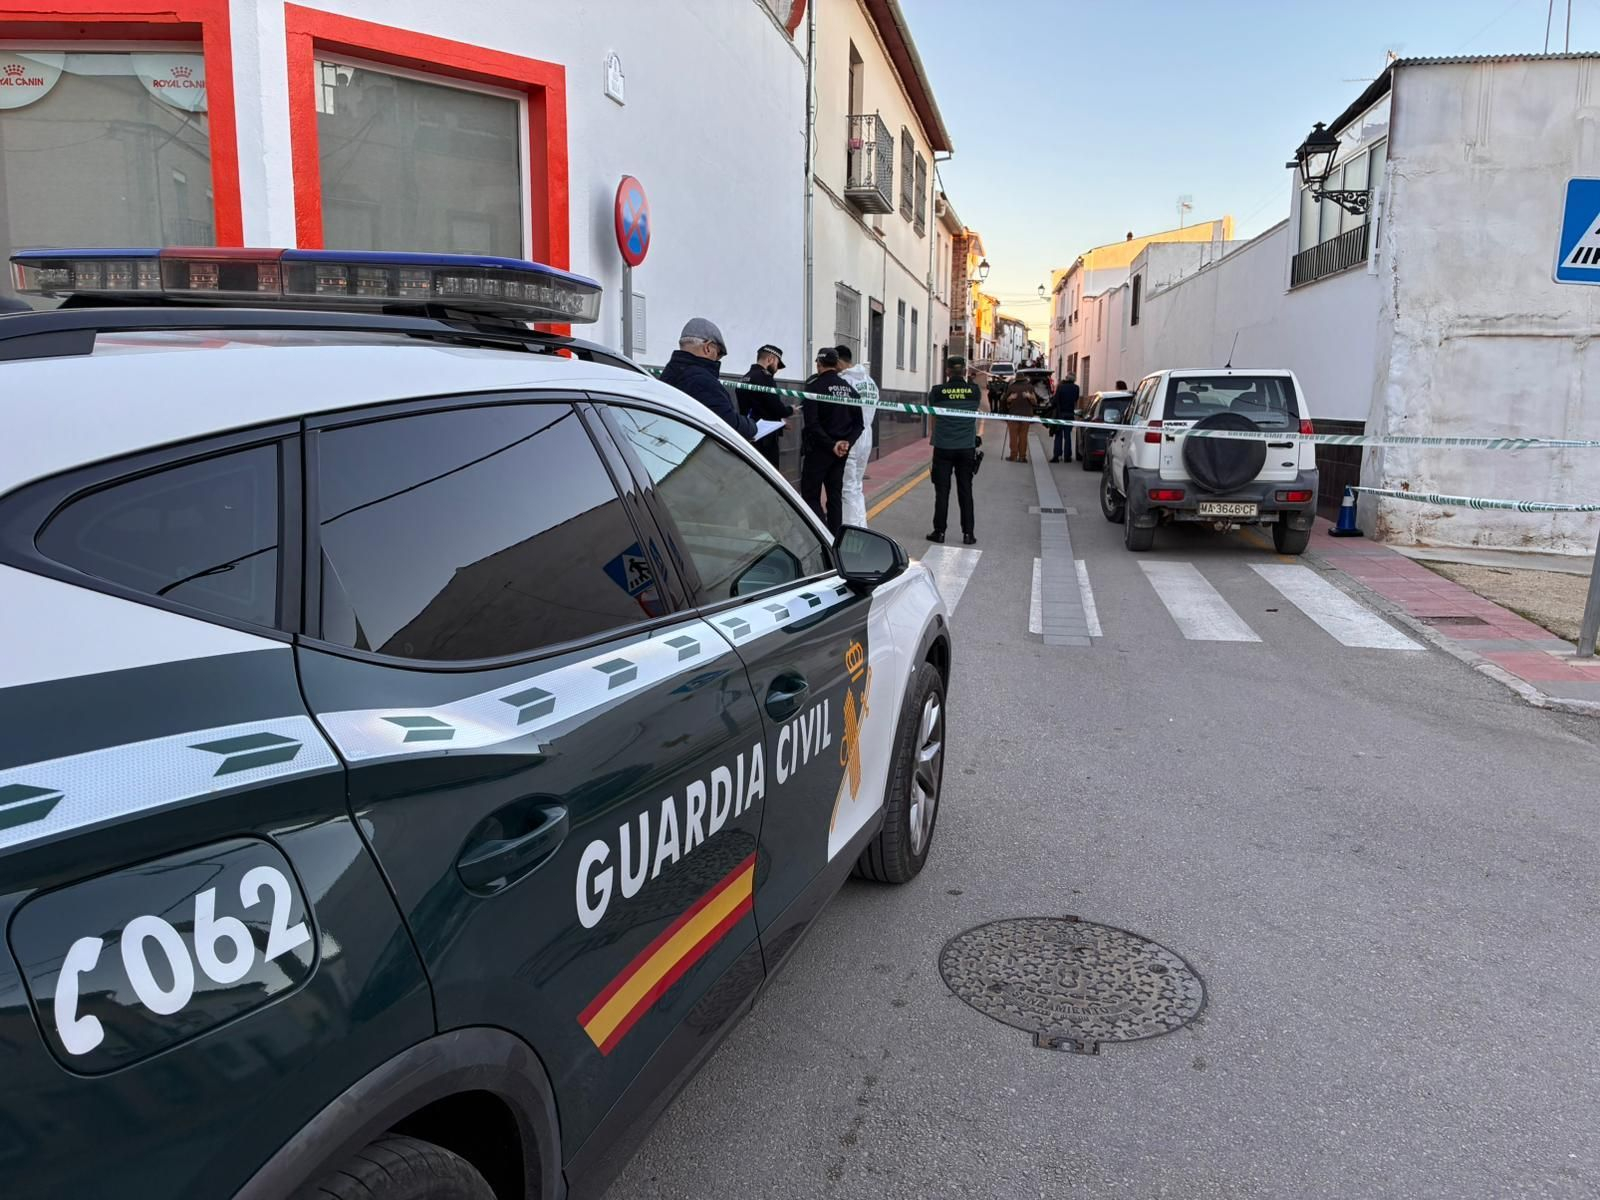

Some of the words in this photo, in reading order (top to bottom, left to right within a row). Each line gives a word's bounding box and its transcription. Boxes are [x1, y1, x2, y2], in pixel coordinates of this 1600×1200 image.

[0, 78, 13, 86] YAL
[15, 77, 44, 86] CANIN
[153, 80, 181, 88] ROYAL
[182, 80, 205, 88] CANI
[576, 742, 765, 928] GUARDIA
[776, 698, 832, 785] CIVIL
[121, 866, 310, 1015] 062
[1012, 991, 1110, 1015] SANEAMIENTO
